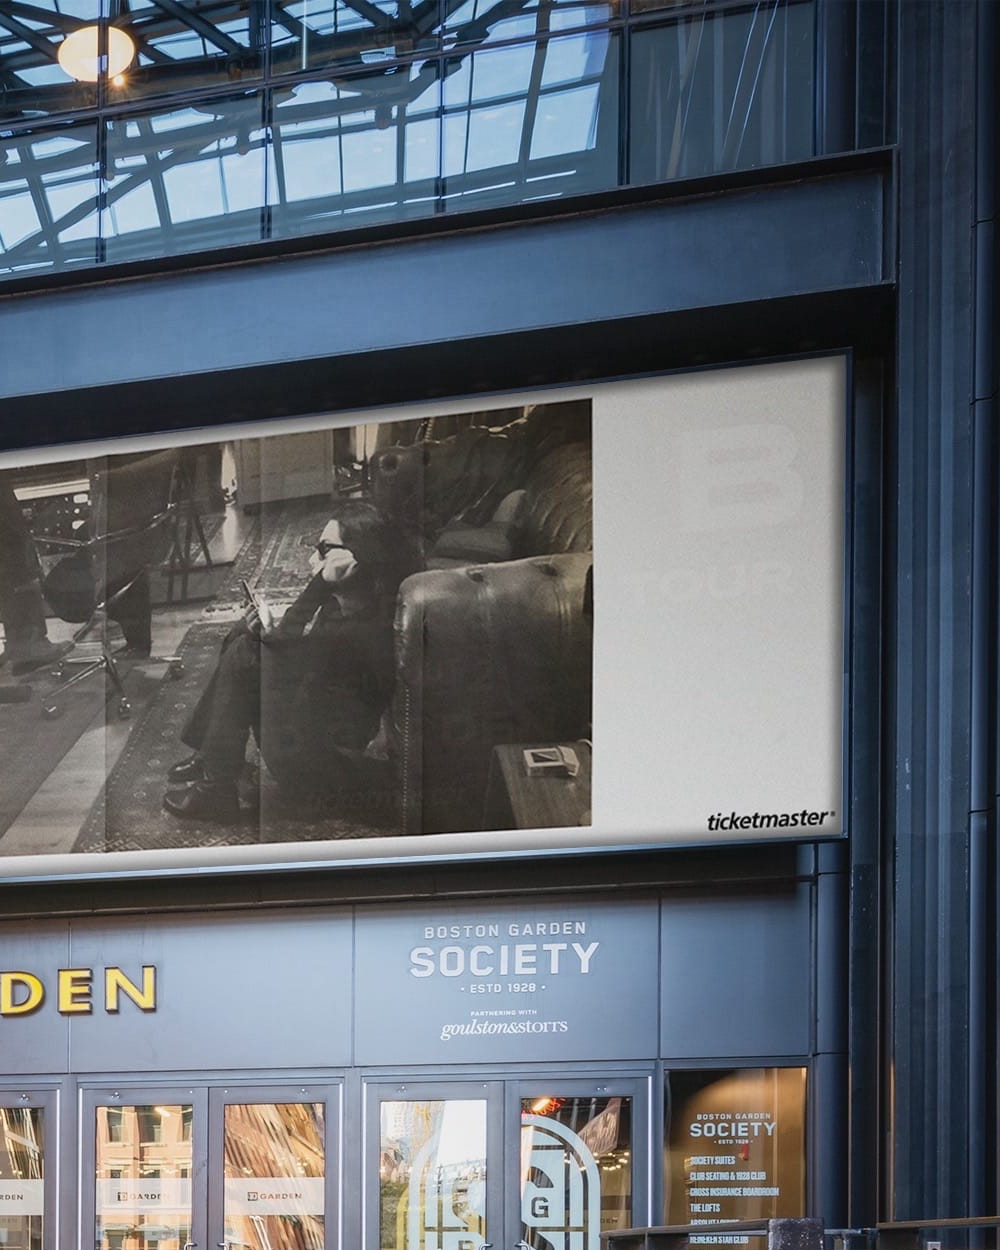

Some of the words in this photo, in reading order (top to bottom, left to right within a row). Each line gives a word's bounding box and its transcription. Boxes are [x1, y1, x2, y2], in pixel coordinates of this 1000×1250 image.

[707, 809, 830, 831] ticketmaster
[424, 924, 499, 939] BOSTON
[508, 921, 587, 937] GARDEN
[409, 942, 600, 978] SOCIETY
[470, 983, 502, 994] ESTD
[507, 983, 537, 993] 1928
[440, 1019, 568, 1041] goulston&storrs
[696, 1113, 732, 1121] BOSTON
[735, 1112, 771, 1120] GARDEN
[690, 1122, 776, 1137] SOCIETY
[531, 1197, 549, 1218] G
